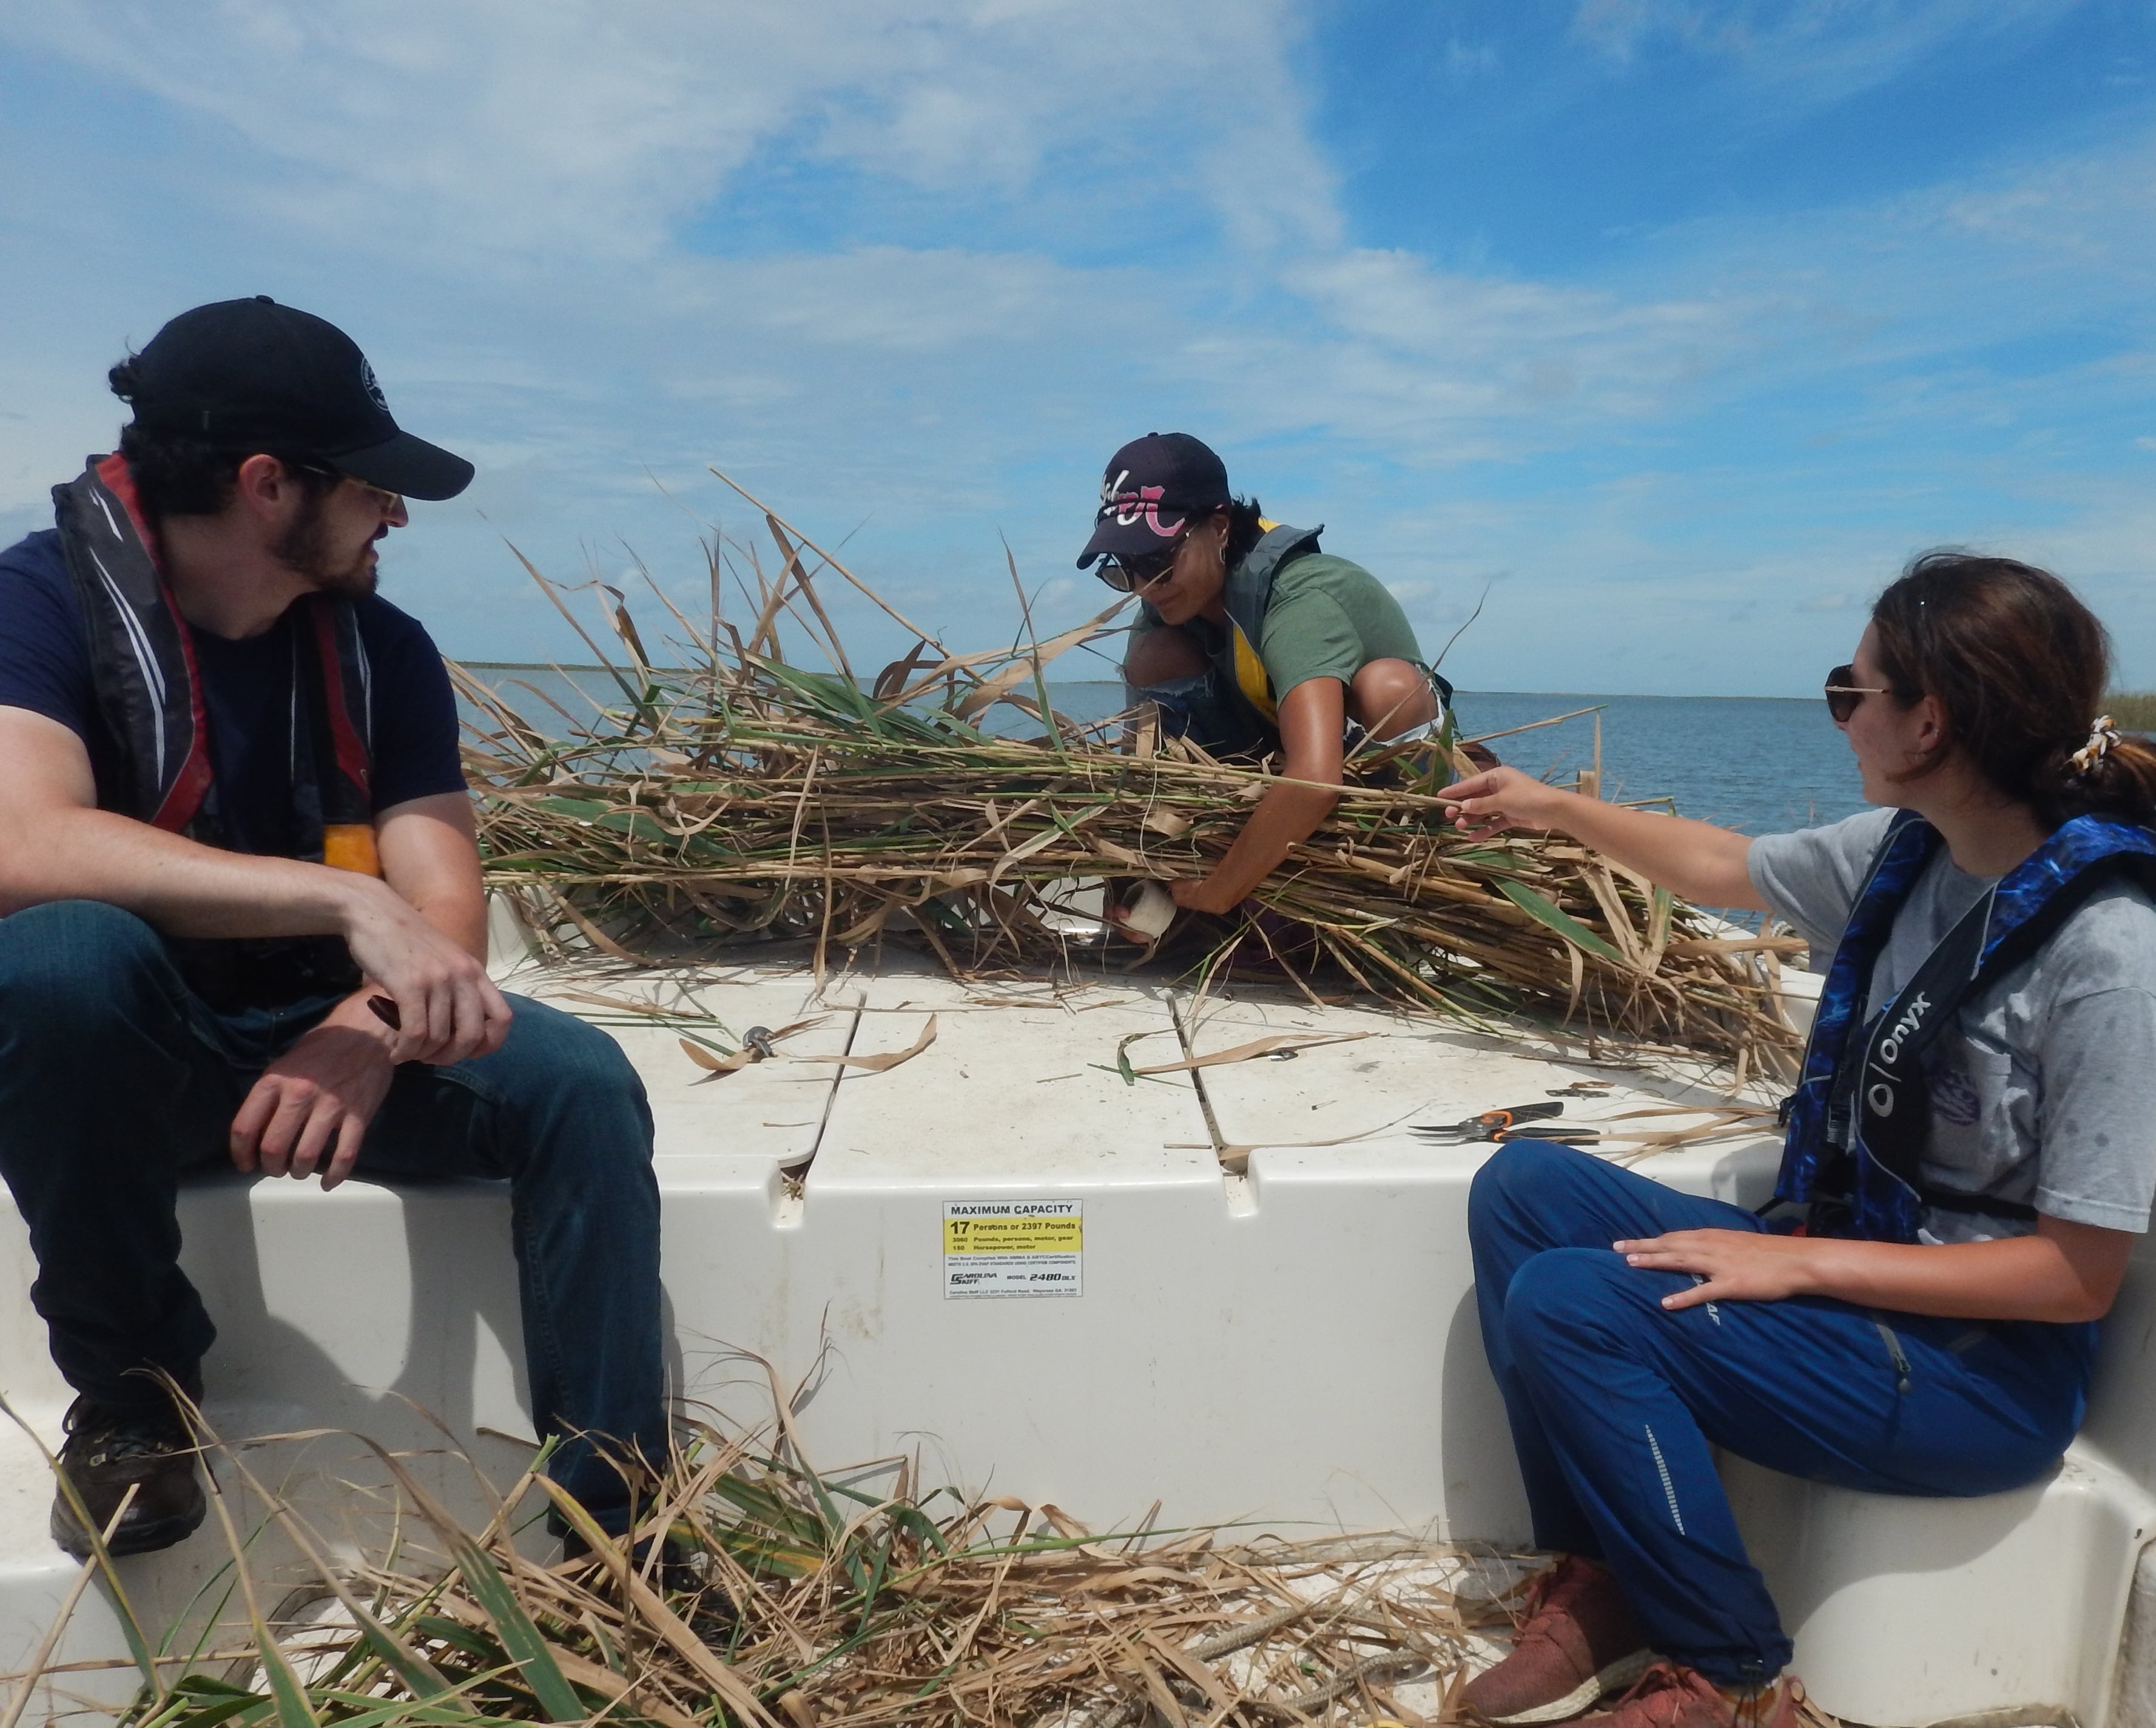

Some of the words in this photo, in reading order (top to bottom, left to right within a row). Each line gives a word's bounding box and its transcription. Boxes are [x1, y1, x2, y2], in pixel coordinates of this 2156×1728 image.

[951, 1206, 1010, 1215] MAXIMUM
[1014, 1205, 1073, 1214] CAPACITY
[951, 1221, 970, 1234] 17
[951, 1273, 997, 1281] CAROLINA
